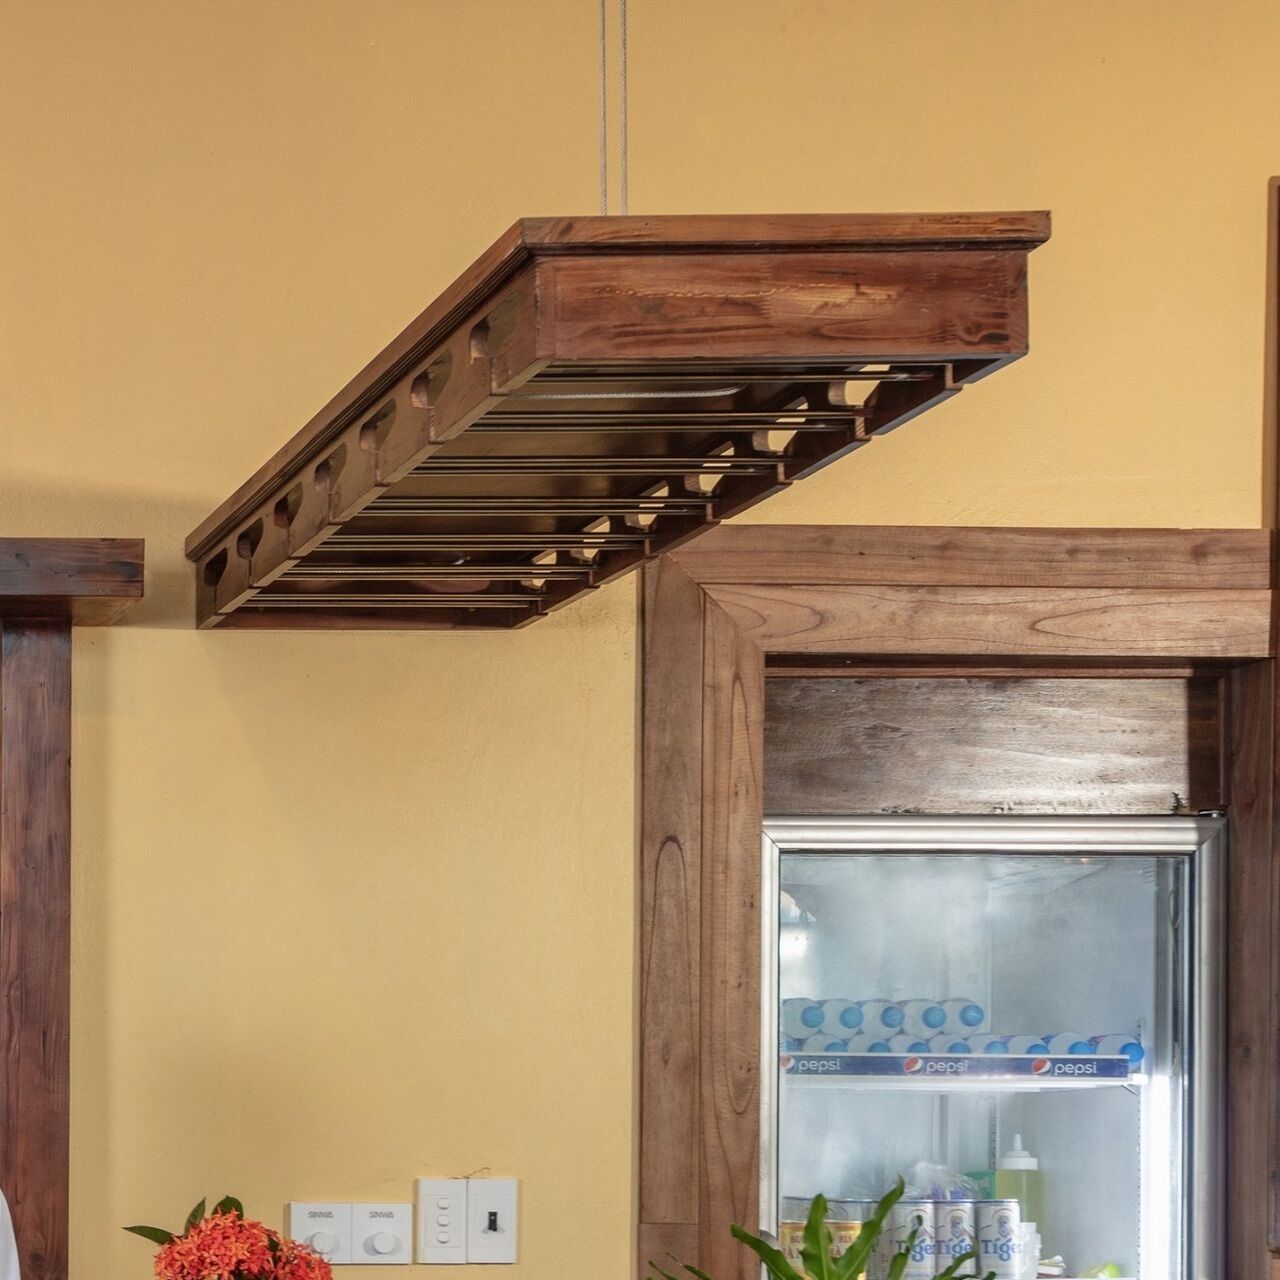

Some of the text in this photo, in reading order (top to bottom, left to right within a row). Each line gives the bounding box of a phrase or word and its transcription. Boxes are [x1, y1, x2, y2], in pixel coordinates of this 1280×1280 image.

[798, 1058, 841, 1073] pepsi
[926, 1059, 968, 1074] pepsi
[1054, 1060, 1097, 1076] pepsi
